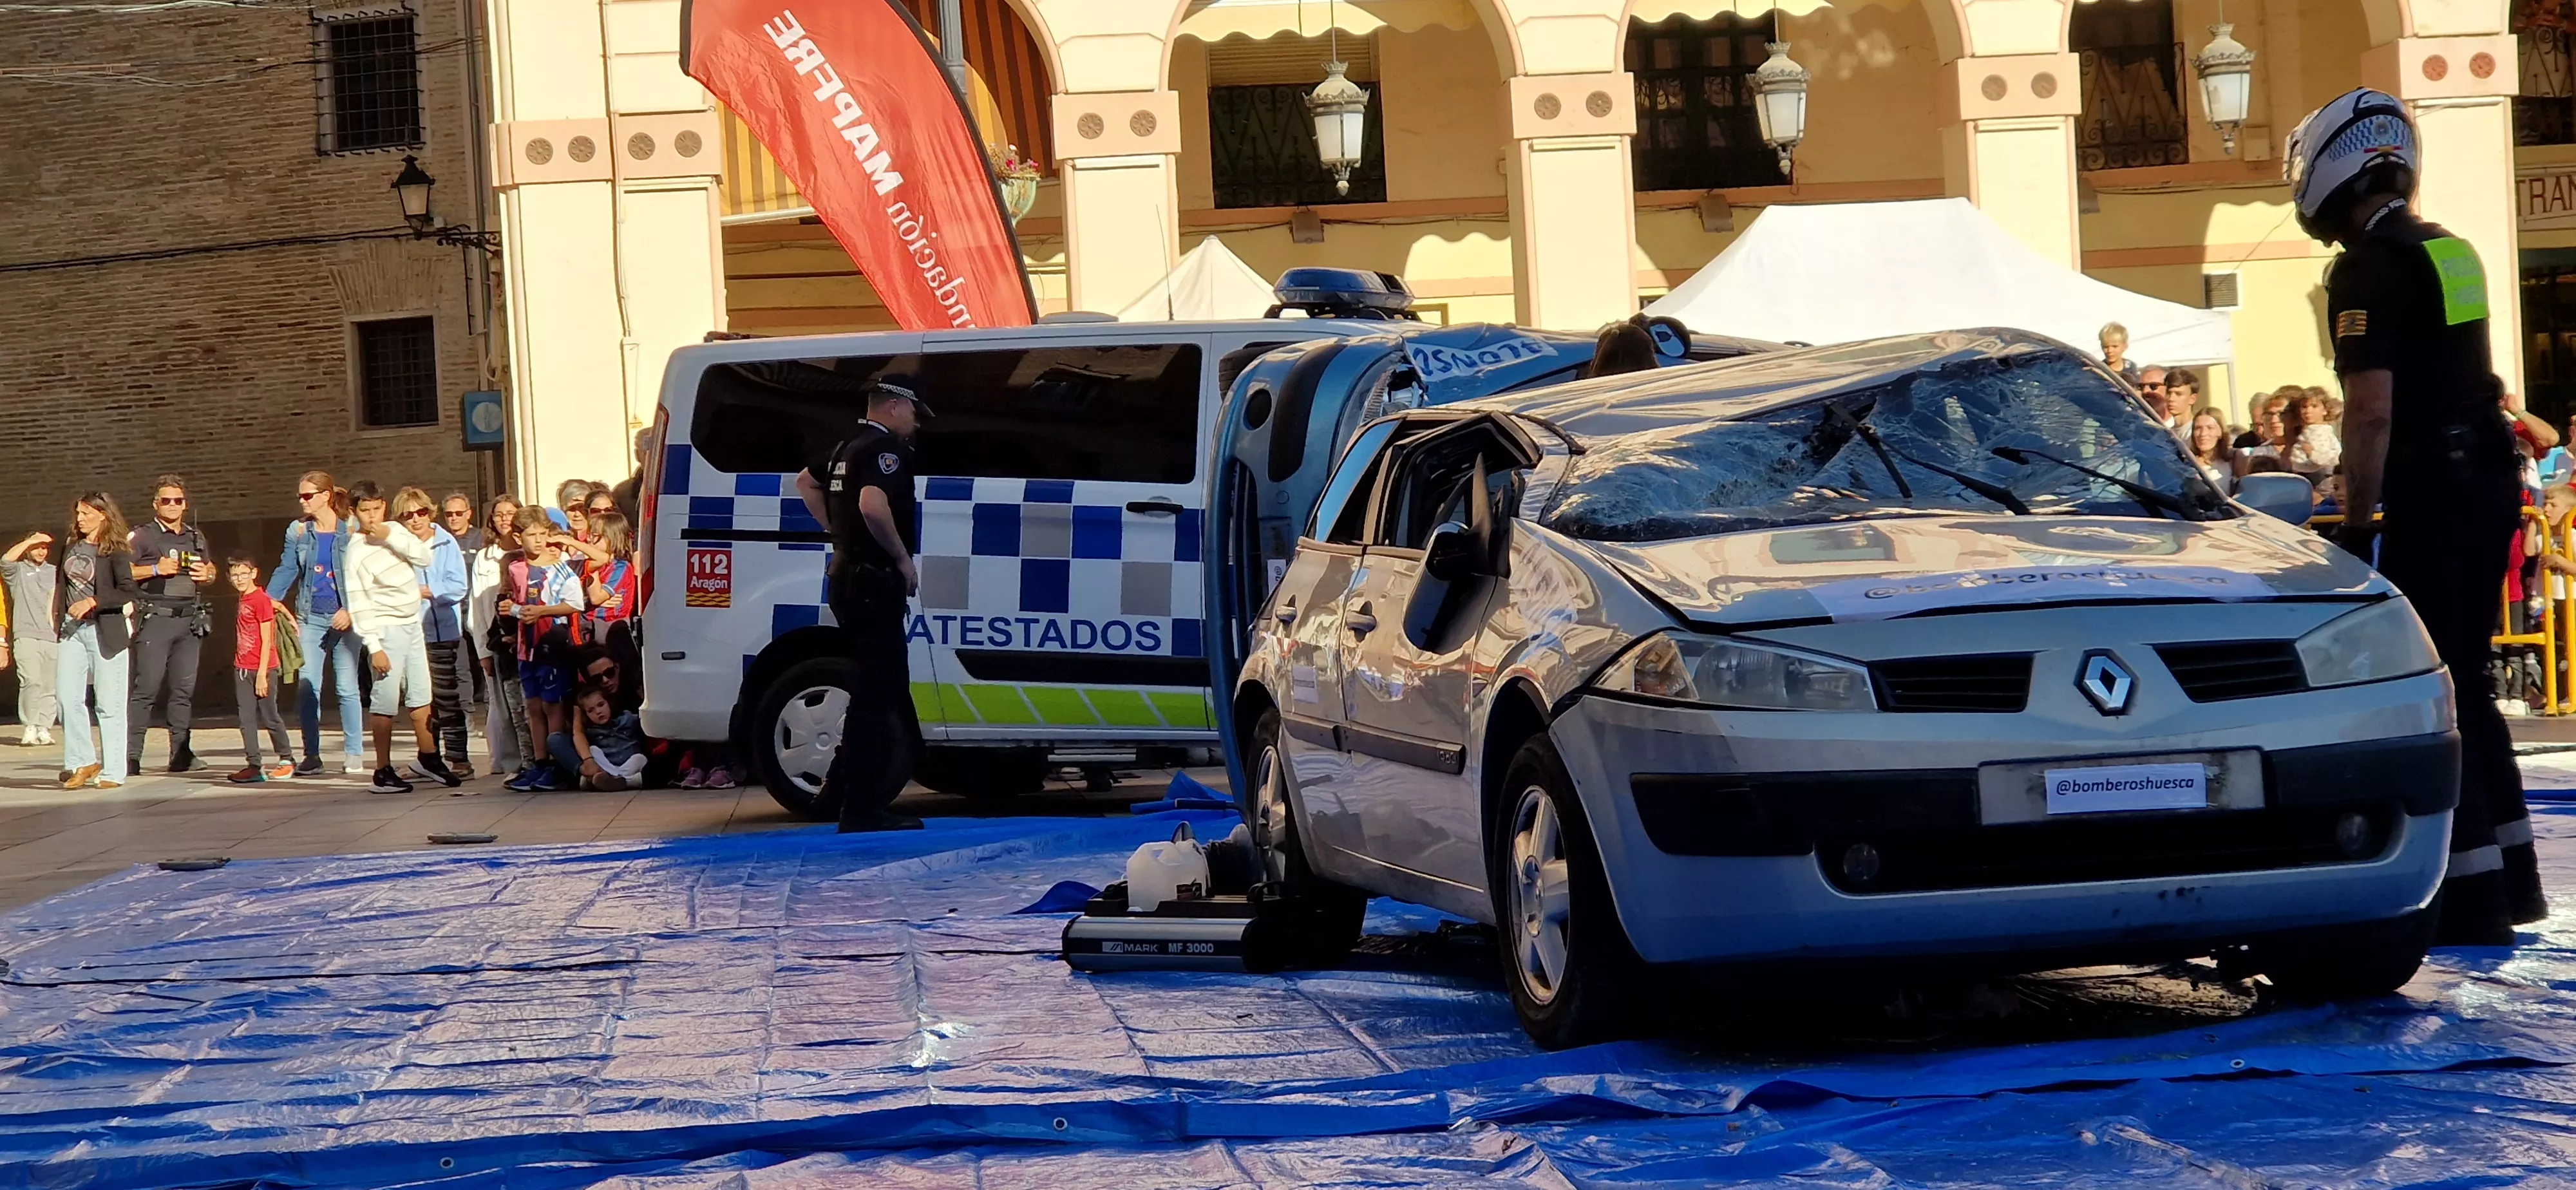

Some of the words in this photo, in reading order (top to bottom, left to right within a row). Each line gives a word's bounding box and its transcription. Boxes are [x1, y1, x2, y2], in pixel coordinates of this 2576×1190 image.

[690, 553, 728, 574] 112
[690, 575, 728, 592] Aragón
[1864, 570, 2229, 599] @boberosueca
[906, 614, 1162, 652] ATESTADOS
[2056, 777, 2194, 795] @bomberoshuesca
[1124, 943, 1159, 952] MARK
[1168, 943, 1184, 953] MF
[1186, 943, 1214, 953] 3000
